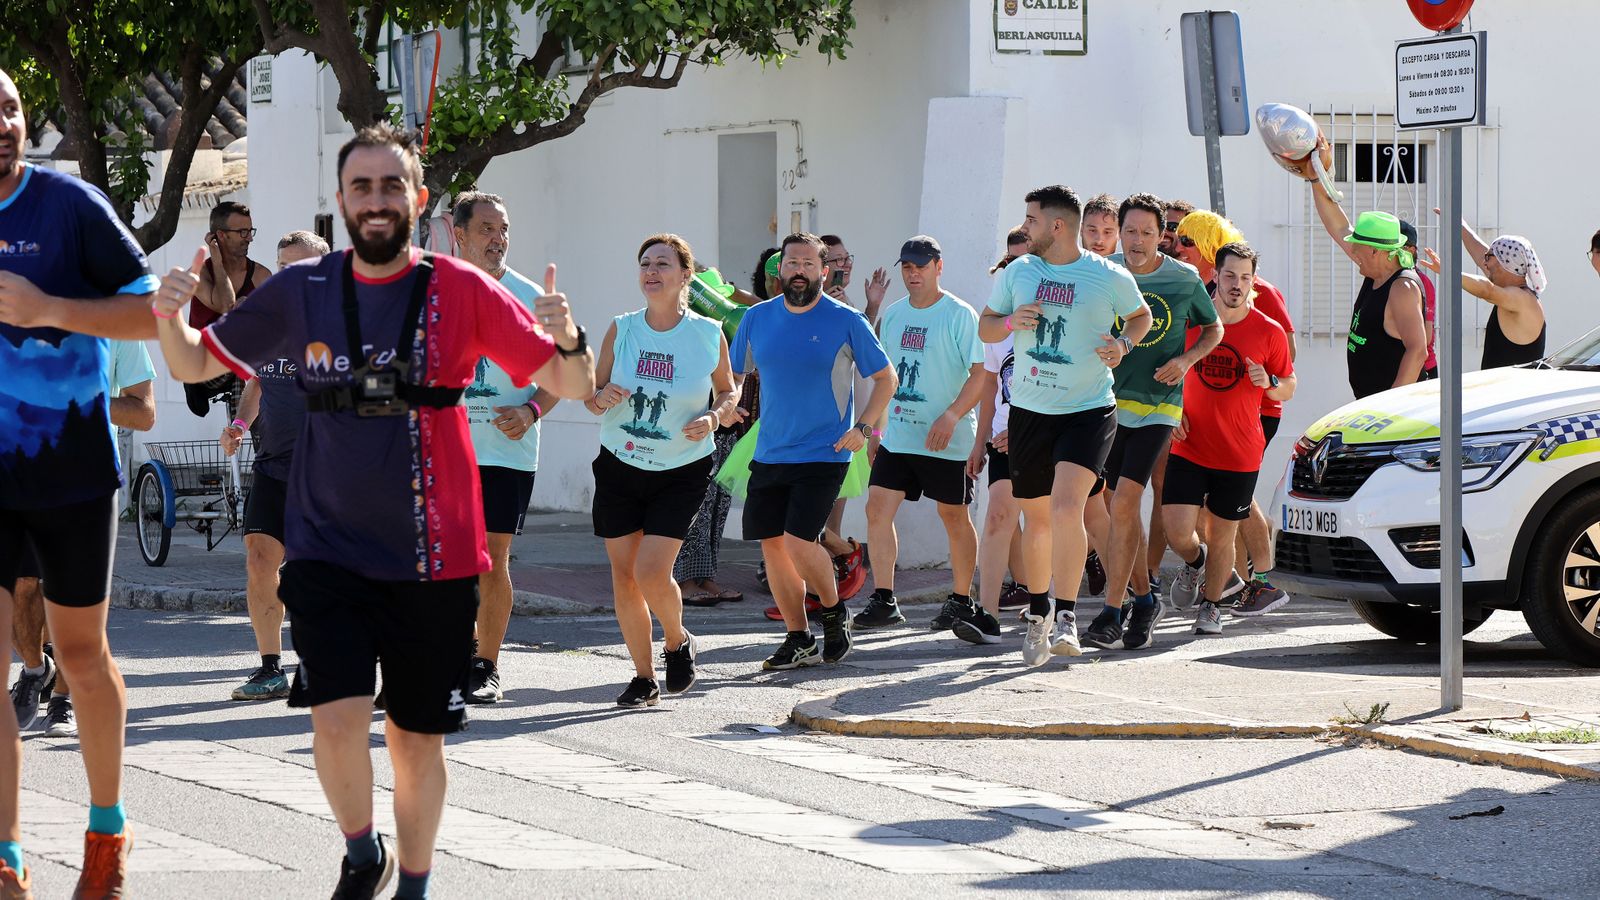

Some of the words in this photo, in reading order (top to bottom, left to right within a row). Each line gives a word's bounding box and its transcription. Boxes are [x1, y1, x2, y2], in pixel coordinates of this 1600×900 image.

[1022, 0, 1079, 10] CALLE
[998, 31, 1083, 41] BERLANGUILLA
[1402, 55, 1423, 64] EXCEPTO
[1423, 53, 1440, 62] CARGA
[1441, 52, 1444, 60] Y
[1445, 49, 1471, 60] DESCARGA
[257, 60, 272, 71] CALLE
[1399, 74, 1412, 82] Lunes
[1416, 71, 1433, 80] Viernes
[1433, 70, 1439, 78] de
[1440, 68, 1453, 77] 08:30
[251, 84, 272, 96] ANTONIO
[1440, 104, 1457, 113] minutos
[1036, 284, 1074, 304] BARRO
[901, 332, 925, 349] BARRO
[639, 349, 645, 358] V
[645, 351, 666, 360] carrera
[1206, 354, 1233, 366] IRON
[636, 359, 674, 380] BARRO
[1205, 368, 1232, 379] CLUB
[1288, 508, 1313, 531] 2213
[1315, 510, 1338, 534] MGB
